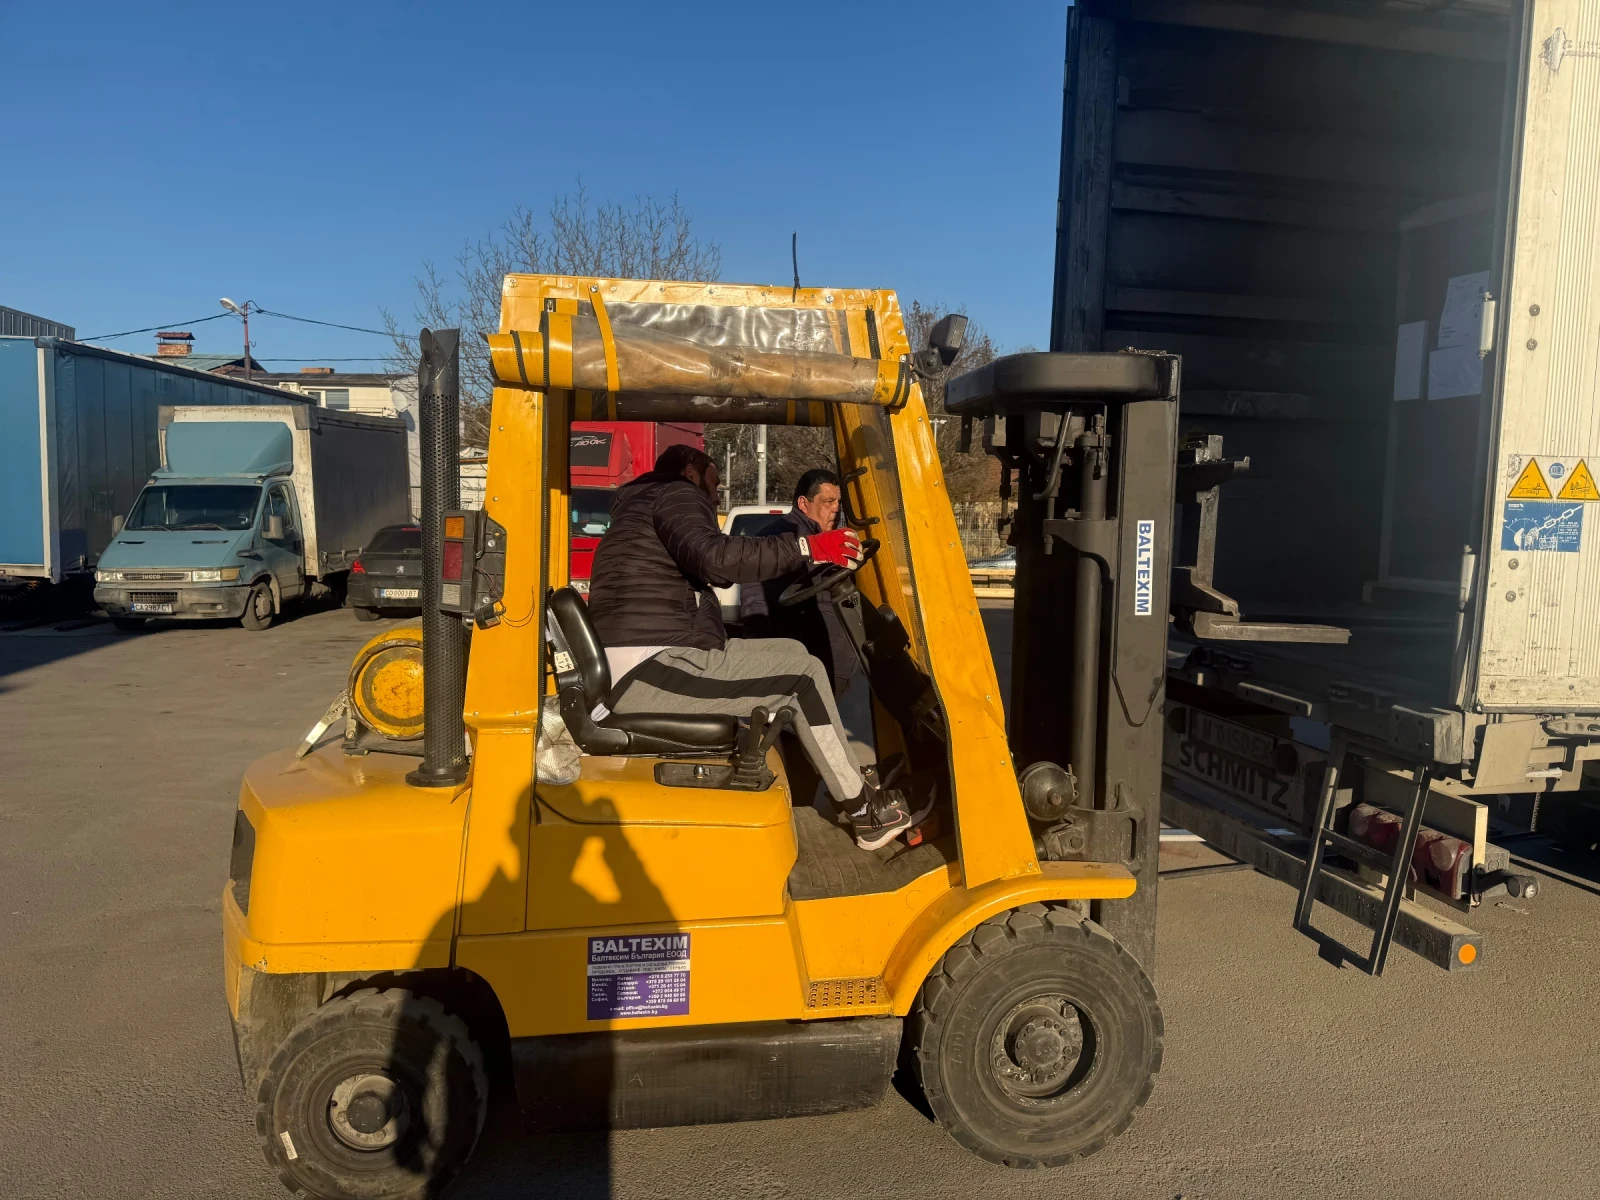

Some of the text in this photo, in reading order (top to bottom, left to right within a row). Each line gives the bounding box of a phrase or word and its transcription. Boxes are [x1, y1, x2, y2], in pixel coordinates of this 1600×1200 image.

[1136, 523, 1151, 612] BALTEXIM
[1180, 741, 1290, 809] SCHMITZ
[592, 936, 687, 953] BALTEXIM
[592, 954, 629, 962] Балтексим
[666, 950, 687, 958] ЕООД
